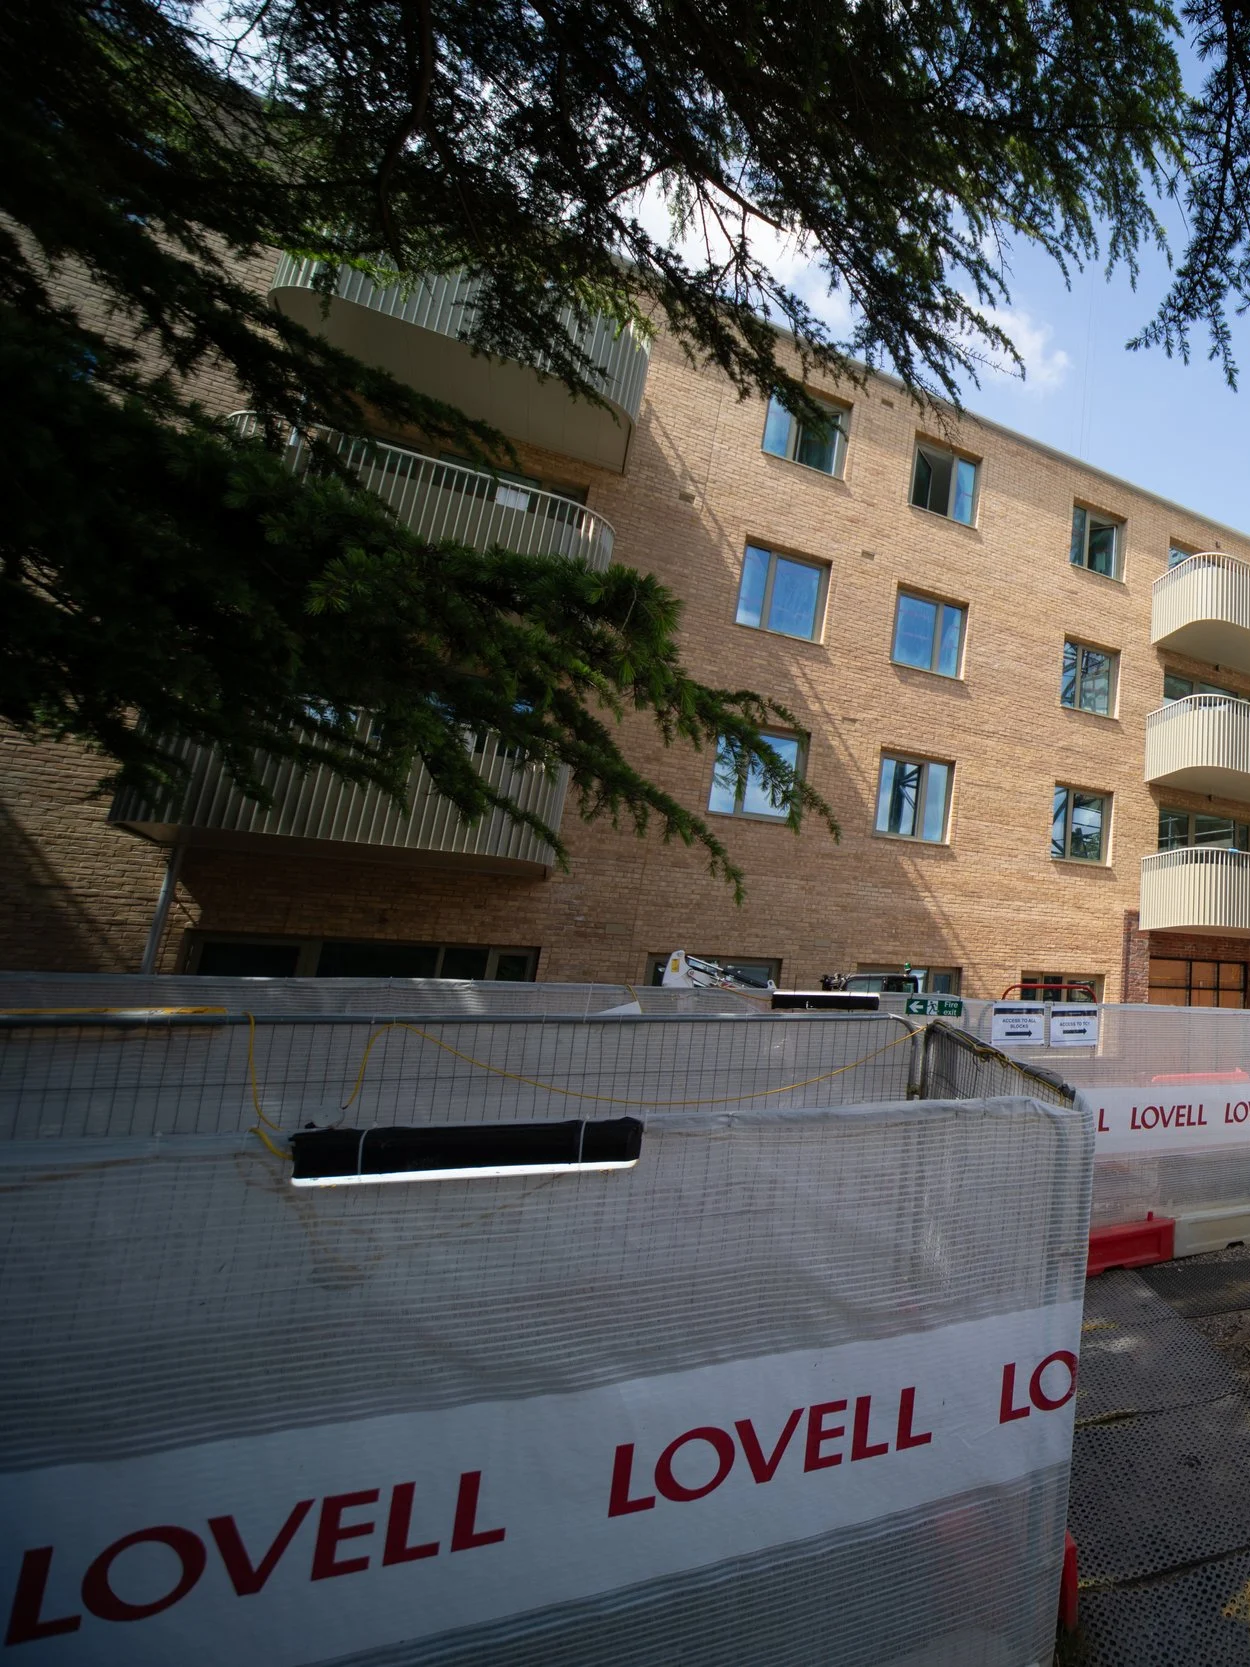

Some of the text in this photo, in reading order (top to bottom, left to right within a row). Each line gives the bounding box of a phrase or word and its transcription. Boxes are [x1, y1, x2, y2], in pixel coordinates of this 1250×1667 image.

[944, 1001, 959, 1009] Fire
[1130, 1104, 1207, 1130] LOVELL
[5, 1471, 506, 1648] LOVELL
[609, 1387, 932, 1518] LOVELL
